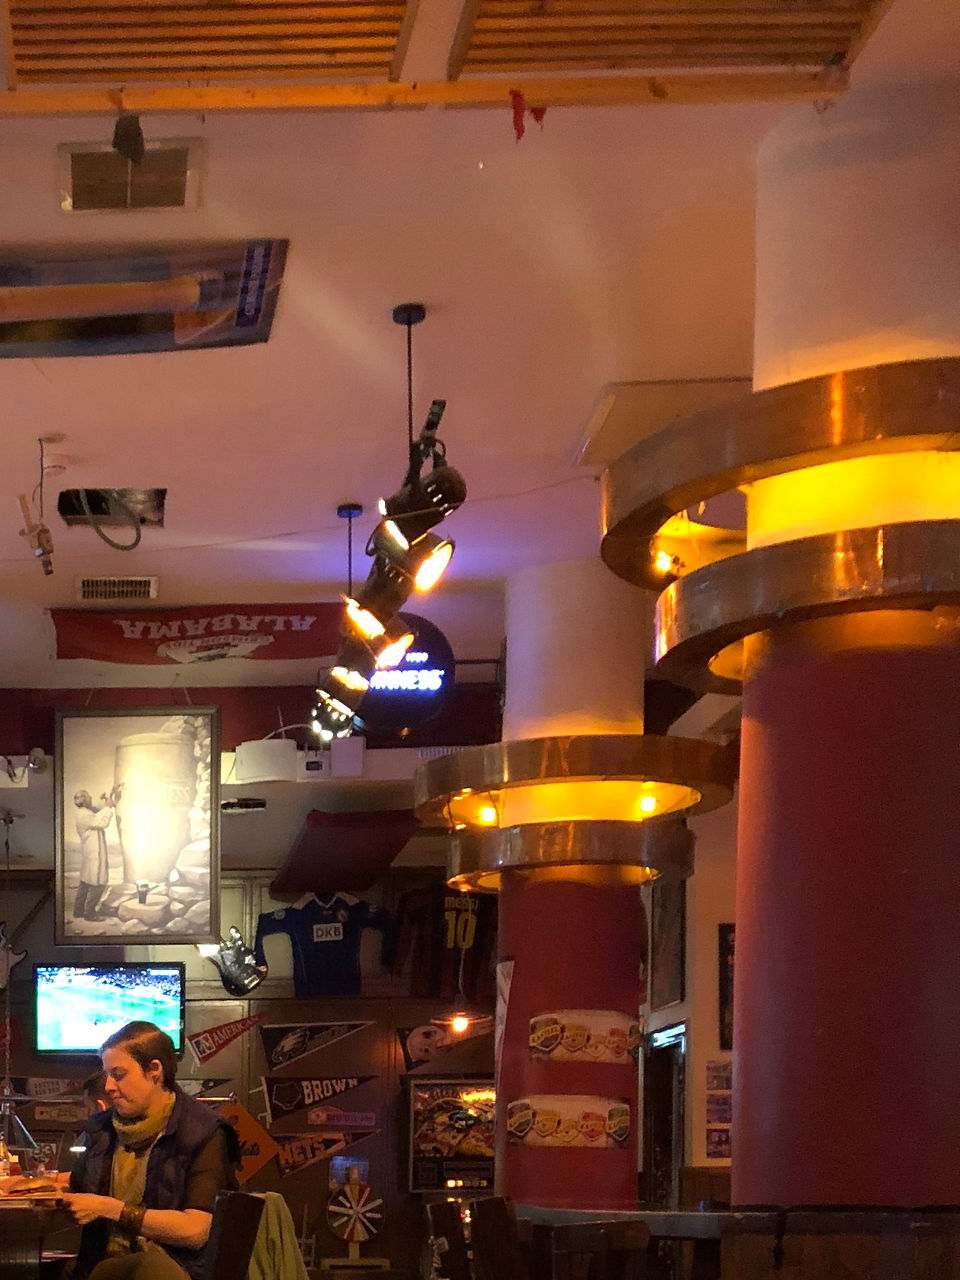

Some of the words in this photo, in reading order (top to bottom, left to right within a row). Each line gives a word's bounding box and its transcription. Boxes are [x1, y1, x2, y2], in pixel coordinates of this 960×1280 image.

[114, 615, 317, 640] ALABAMA
[370, 669, 445, 690] INNESS
[315, 926, 341, 938] DKB
[444, 911, 478, 949] 10
[301, 1078, 358, 1105] BROWN
[279, 1135, 327, 1164] METS
